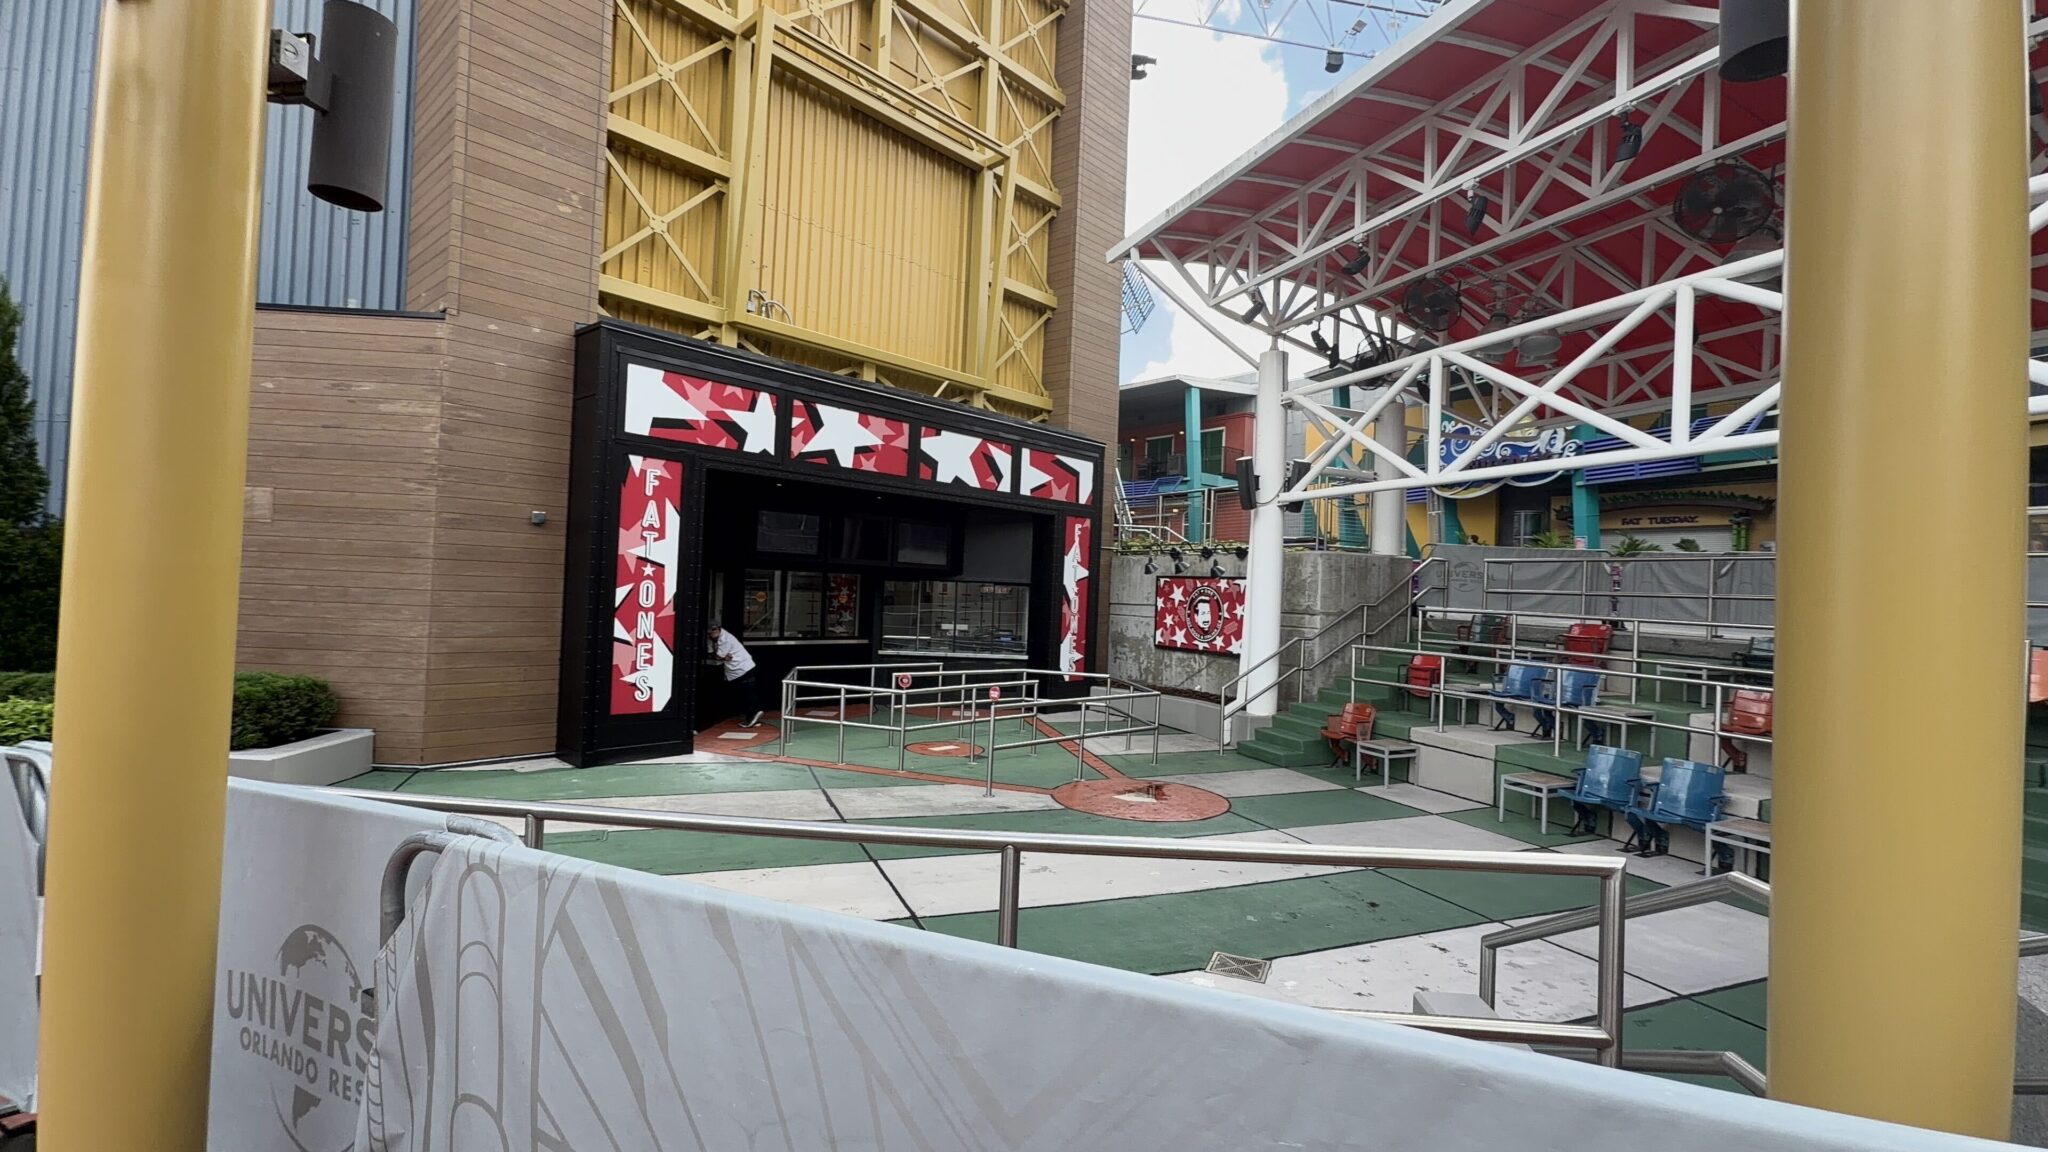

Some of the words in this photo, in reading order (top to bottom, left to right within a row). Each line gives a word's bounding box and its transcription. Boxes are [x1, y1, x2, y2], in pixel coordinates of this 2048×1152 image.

[642, 468, 662, 559] FAT
[1621, 517, 1642, 526] FAT
[634, 579, 656, 702] ONES
[240, 1026, 318, 1085] ORLANDO
